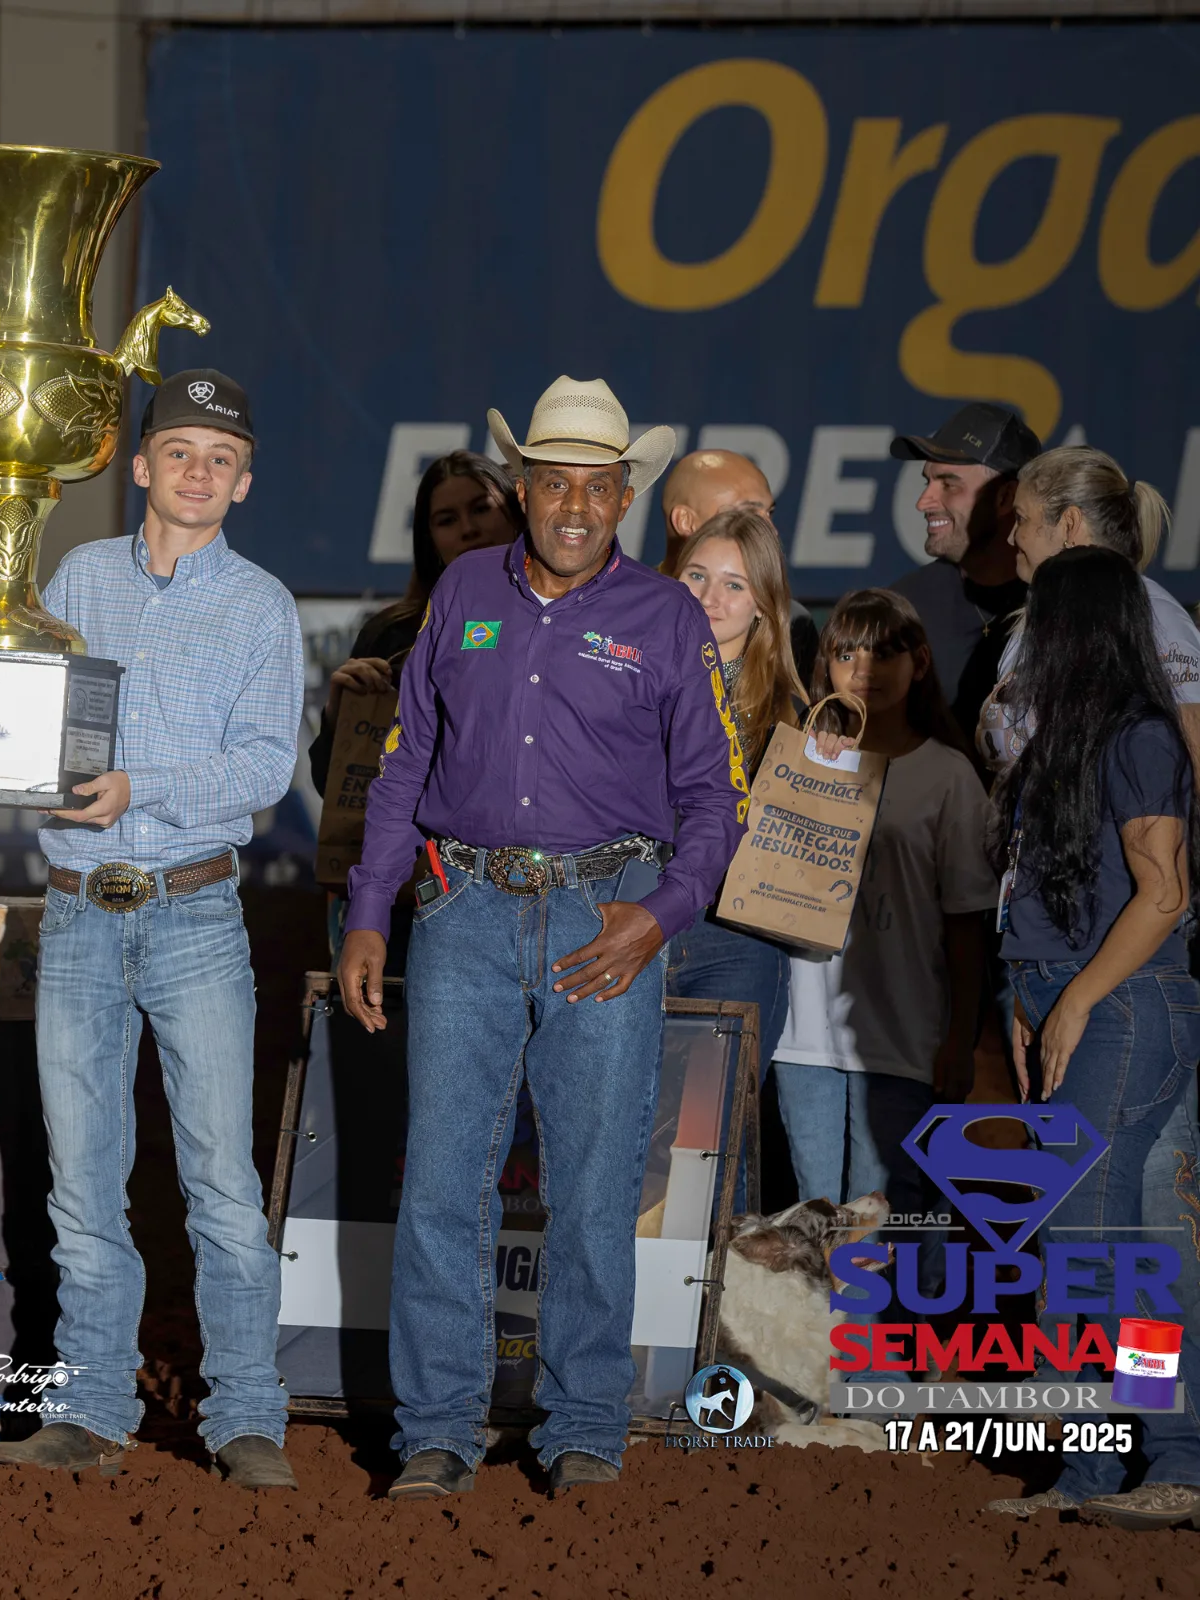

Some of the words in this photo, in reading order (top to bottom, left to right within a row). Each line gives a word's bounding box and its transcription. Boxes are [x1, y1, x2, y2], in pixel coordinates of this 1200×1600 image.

[205, 402, 240, 419] ARIAT
[774, 763, 864, 801] Organnact
[756, 817, 857, 858] ENTREGAM
[770, 807, 831, 833] SUPLEMENTOS
[833, 828, 853, 839] QUE
[750, 834, 853, 873] RESULTADOS.
